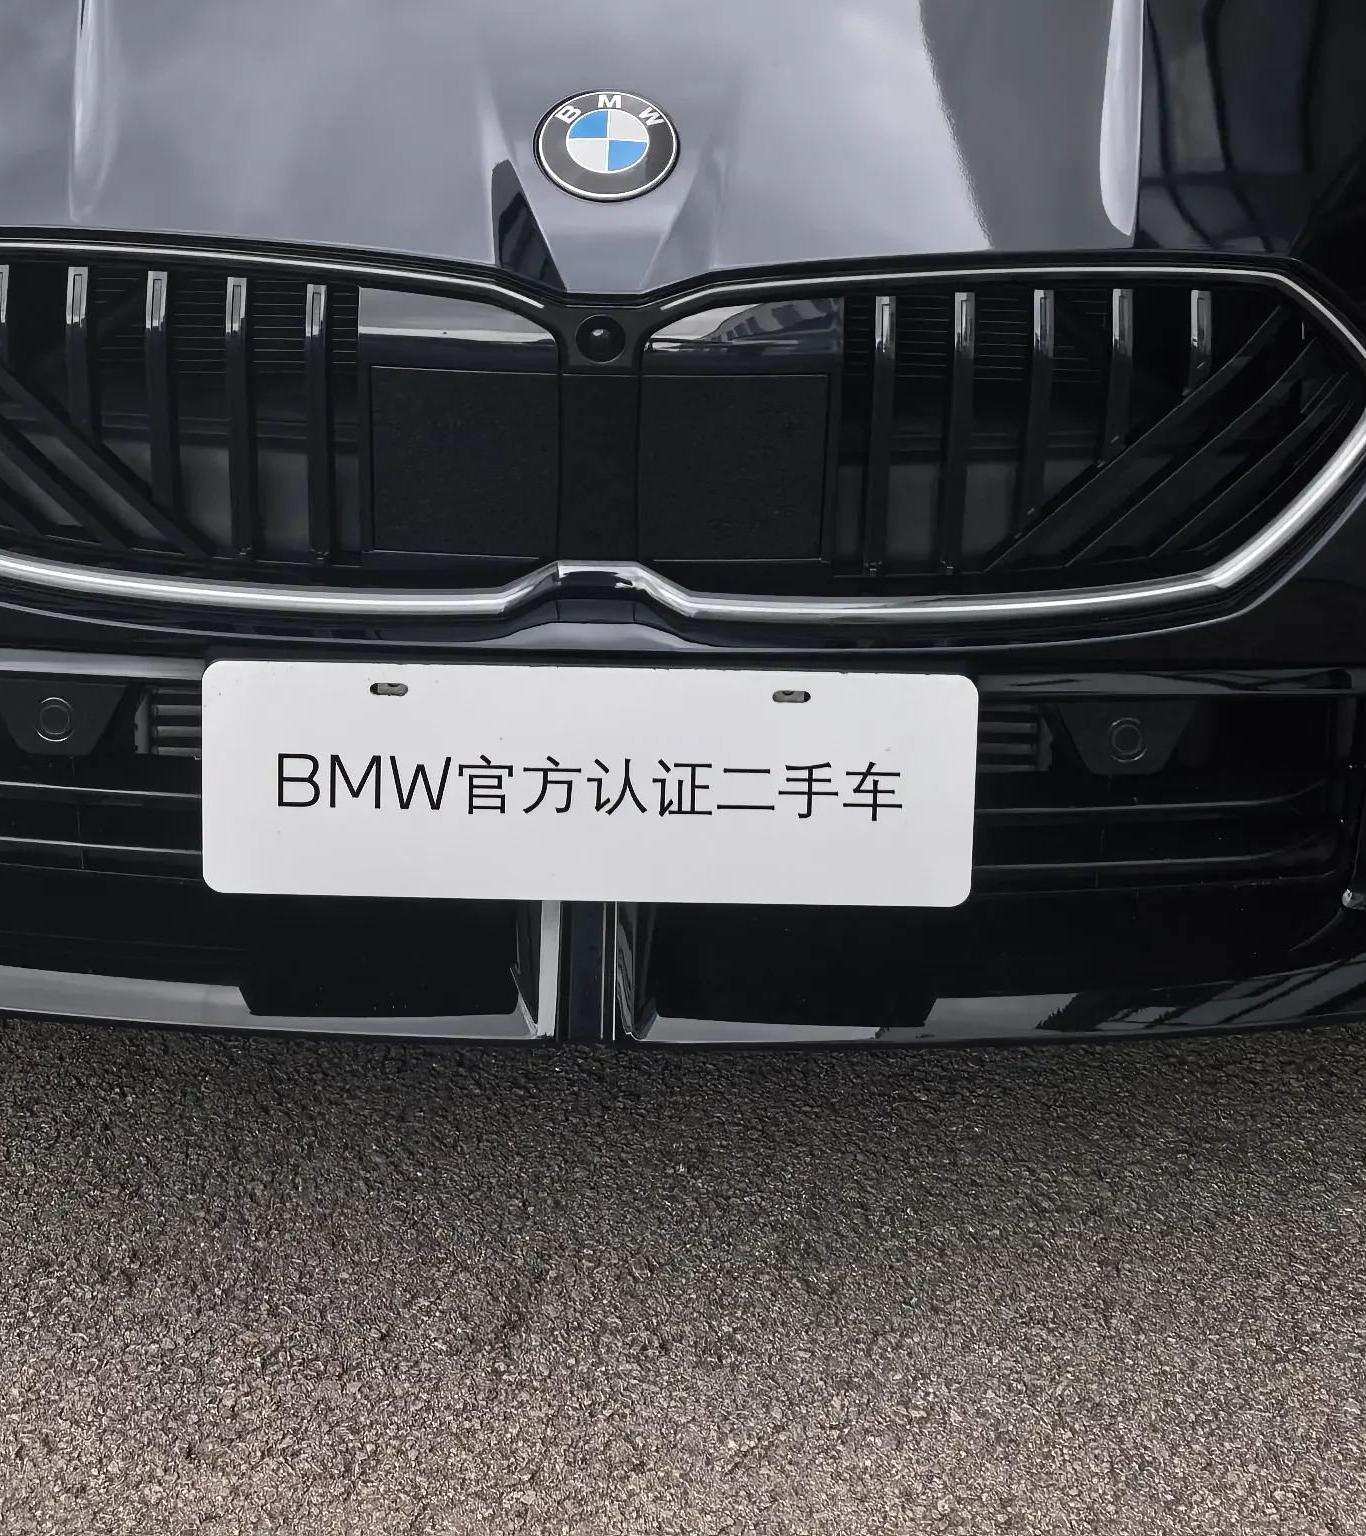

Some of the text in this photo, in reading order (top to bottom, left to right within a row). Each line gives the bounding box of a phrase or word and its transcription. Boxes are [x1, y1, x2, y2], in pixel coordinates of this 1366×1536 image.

[554, 93, 665, 127] BMW
[277, 752, 903, 822] BMW官方认证二手车
